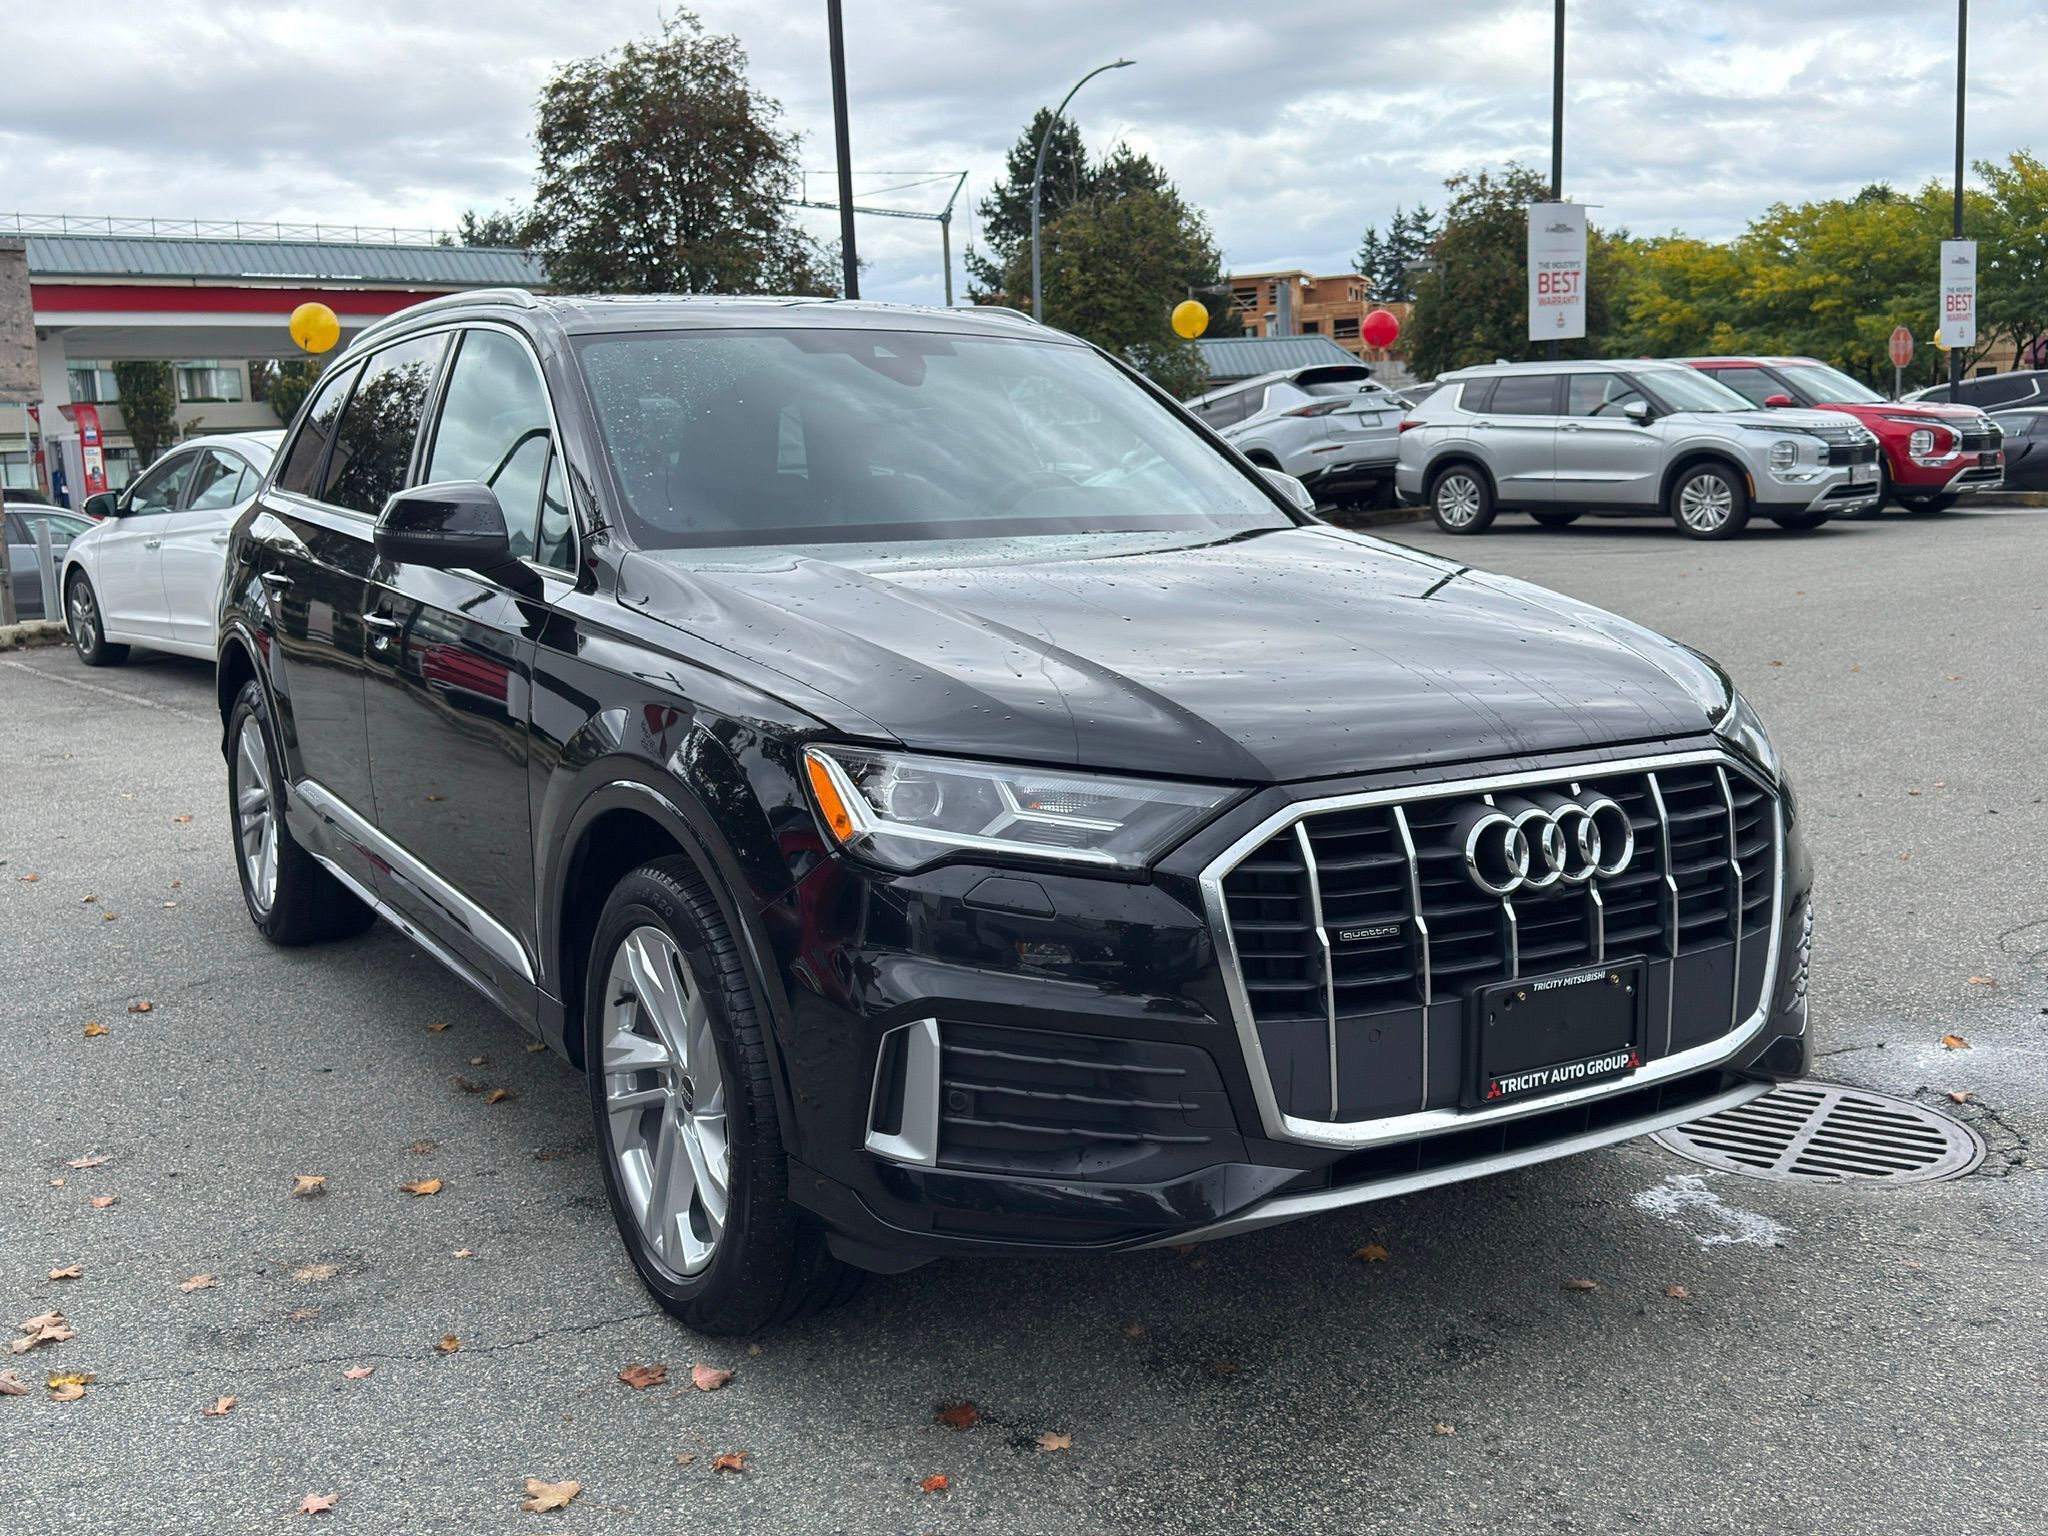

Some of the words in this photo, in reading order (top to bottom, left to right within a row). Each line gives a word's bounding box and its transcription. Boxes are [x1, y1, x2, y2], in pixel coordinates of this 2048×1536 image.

[1538, 272, 1580, 294] BEST
[1946, 295, 1972, 311] BEST
[1343, 927, 1398, 939] quattro
[1533, 978, 1563, 991] TRICITY
[1563, 971, 1606, 986] MITSUBISHI
[1500, 1071, 1550, 1094] TRICITY
[1550, 1063, 1585, 1083] AUTO
[1586, 1054, 1629, 1075] GROUP
